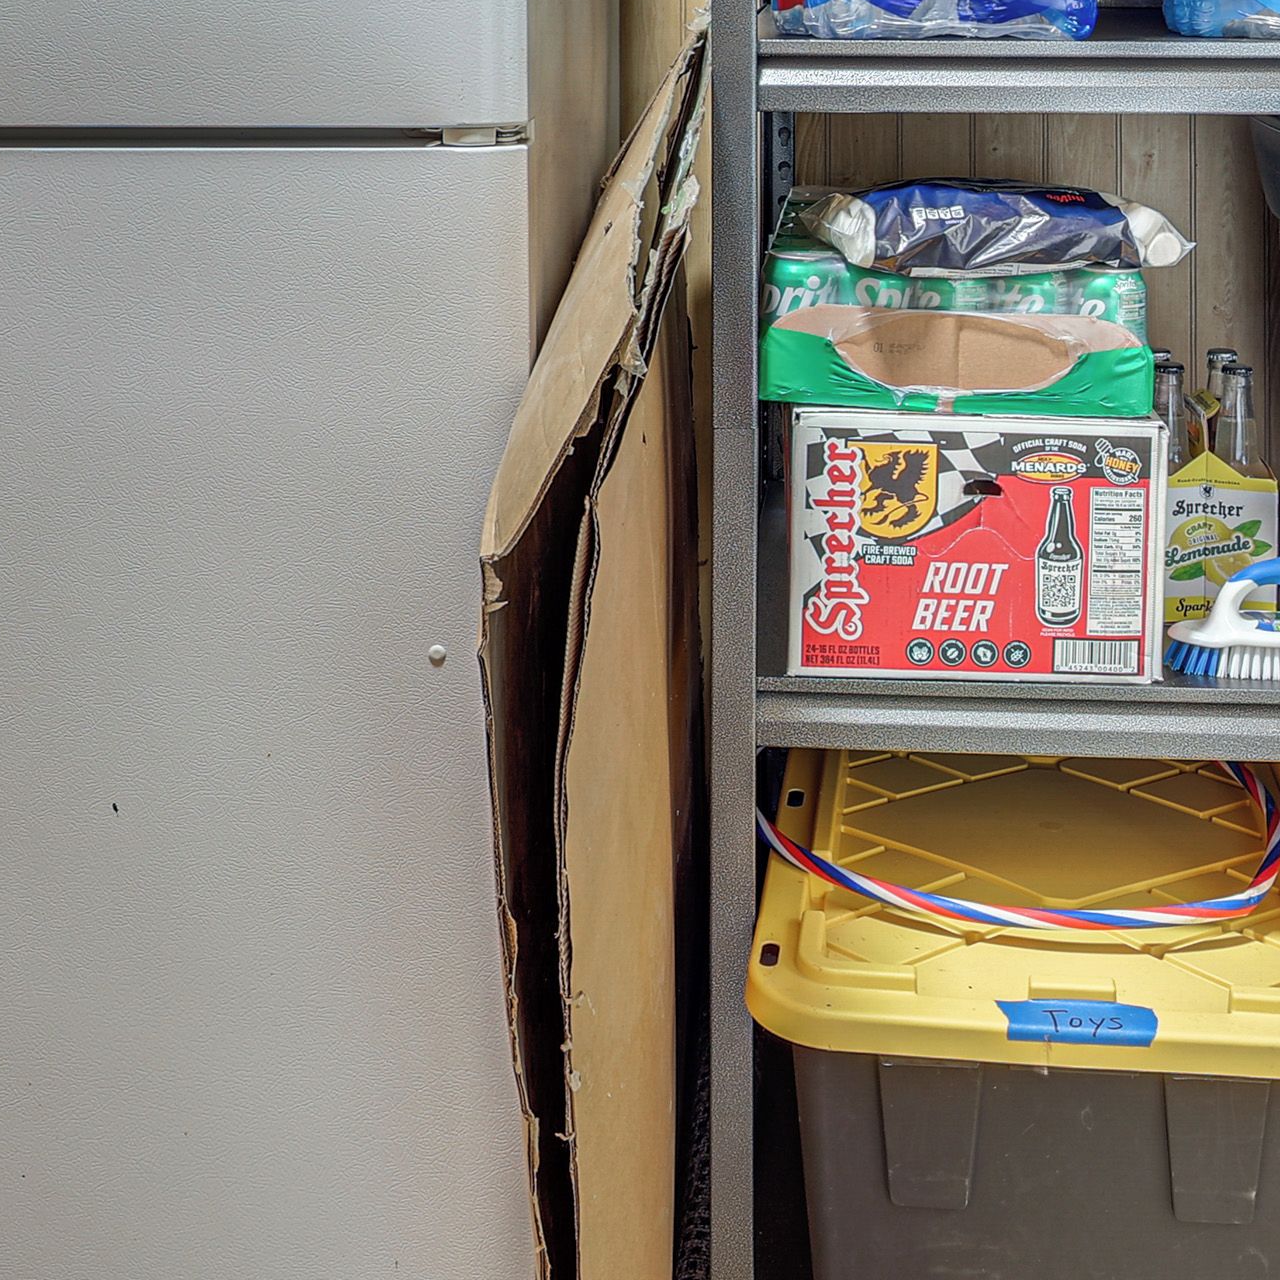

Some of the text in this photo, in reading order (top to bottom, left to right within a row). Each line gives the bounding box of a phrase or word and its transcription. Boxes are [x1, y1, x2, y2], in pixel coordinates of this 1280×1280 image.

[1012, 438, 1087, 453] OFFICIAL CRAFT SODA
[1115, 450, 1135, 460] MADE
[1011, 462, 1086, 473] MENARDS
[1105, 457, 1139, 473] HONEY
[1172, 499, 1243, 519] Sprecher
[1186, 522, 1213, 535] CRAFT
[805, 437, 870, 640] Sprecher
[1189, 535, 1218, 545] ORIGINAL
[862, 545, 917, 556] FIRE-BREWED
[1165, 536, 1251, 567] Lemonade
[864, 555, 913, 565] CRAFT SODA
[1041, 562, 1079, 572] Sprecher
[922, 562, 1009, 595] ROOT
[912, 598, 994, 632] BEER
[829, 645, 836, 654] FL
[838, 645, 847, 654] OZ
[848, 645, 880, 655] BOTTLES
[806, 655, 818, 664] NET
[836, 655, 844, 664] FL
[846, 656, 855, 664] OZ
[1042, 1010, 1123, 1038] Toys
